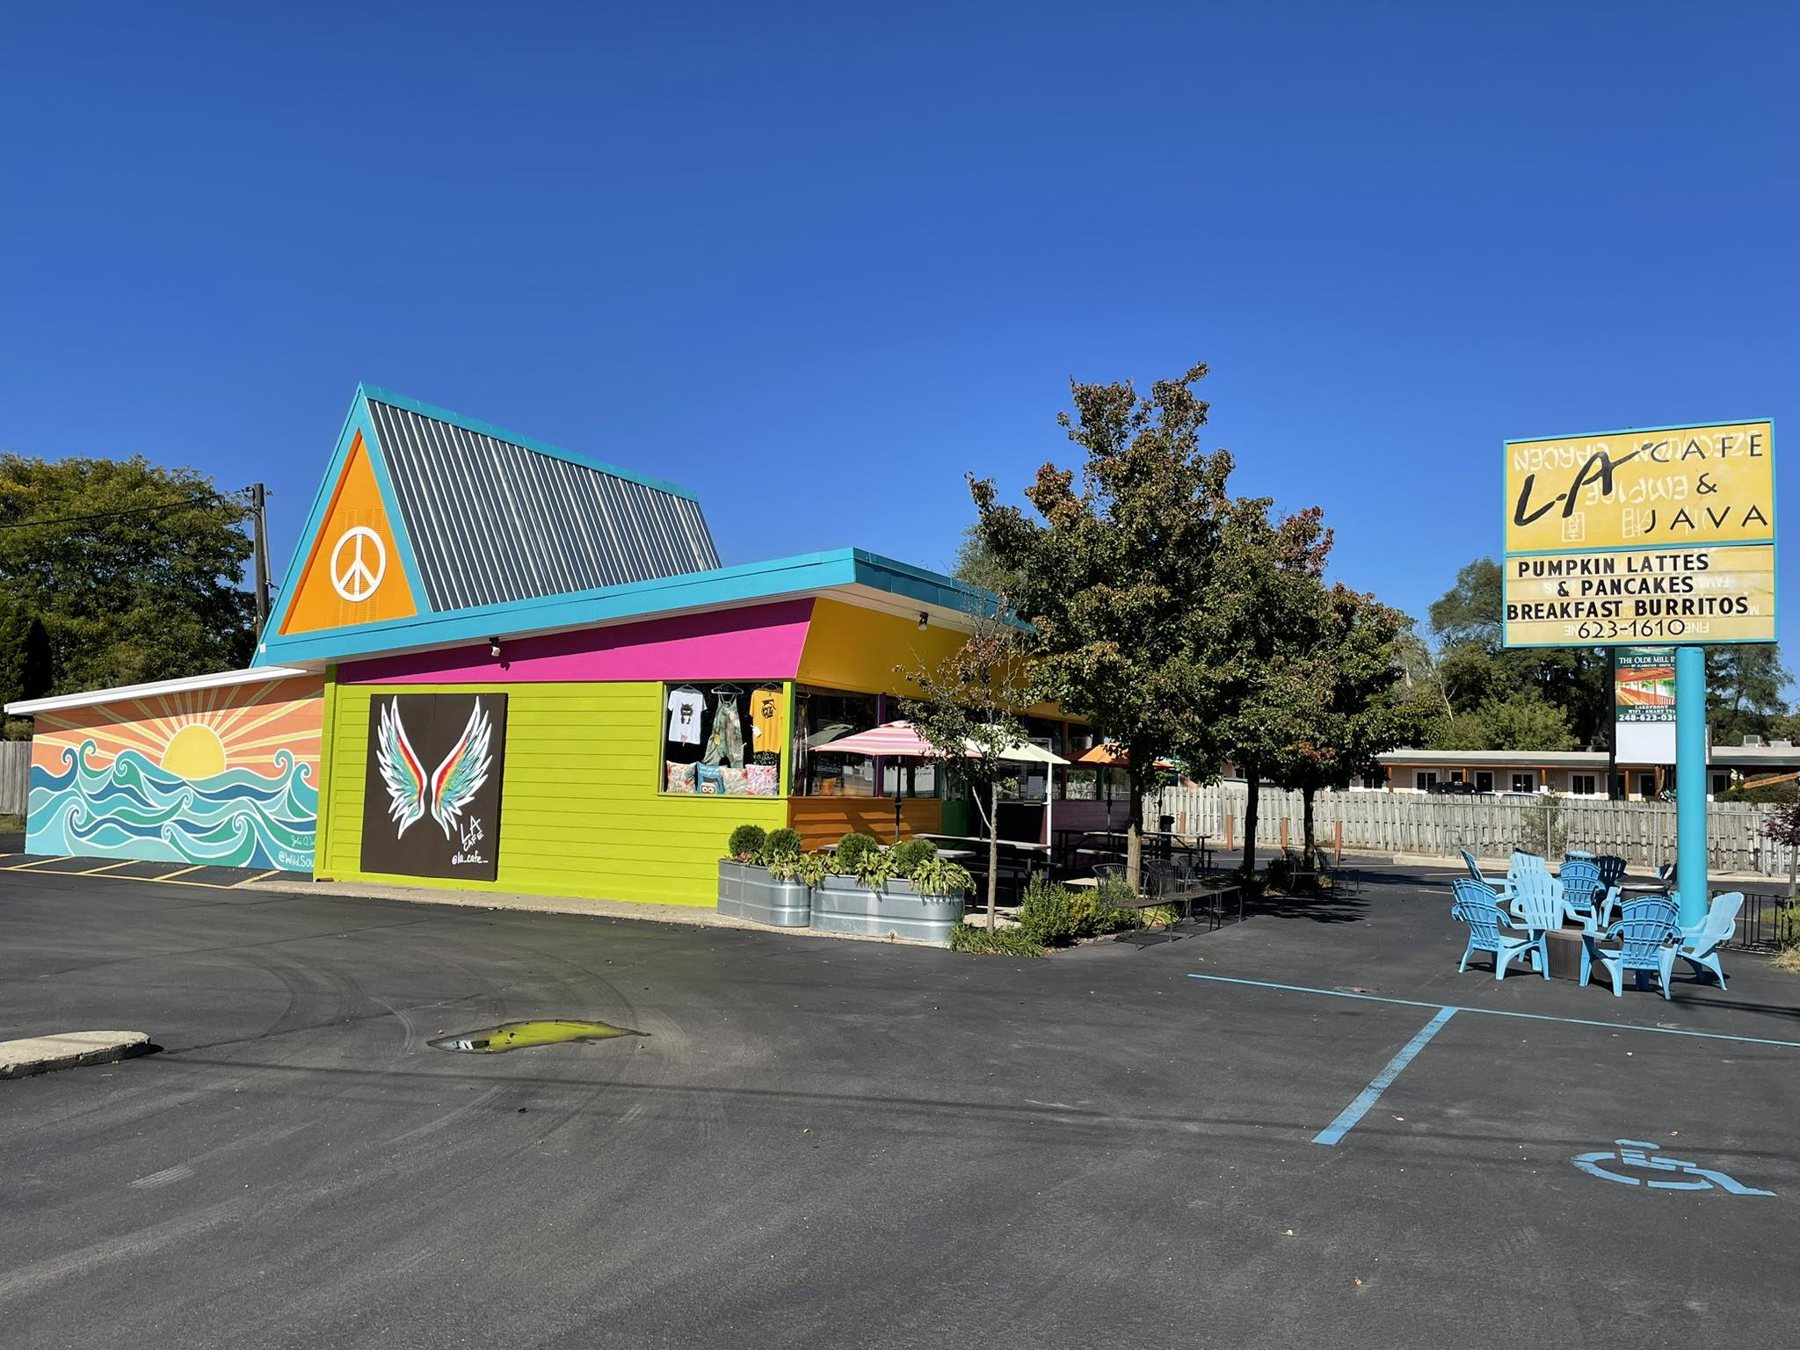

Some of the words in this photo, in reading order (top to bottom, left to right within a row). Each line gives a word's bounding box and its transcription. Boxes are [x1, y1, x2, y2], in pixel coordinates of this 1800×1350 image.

[1650, 433, 1763, 463] CAFE
[1696, 472, 1718, 495] &
[1643, 504, 1768, 534] JAVA
[1518, 557, 1616, 578] PUMPKIN
[1626, 553, 1709, 574] LATTES
[1557, 581, 1570, 597] &
[1581, 575, 1694, 596] PANCAKES
[1506, 600, 1623, 621] BREAKFAST
[1634, 596, 1749, 617] BURRITOS
[1578, 619, 1686, 639] 623-1610
[463, 829, 484, 852] CAFE
